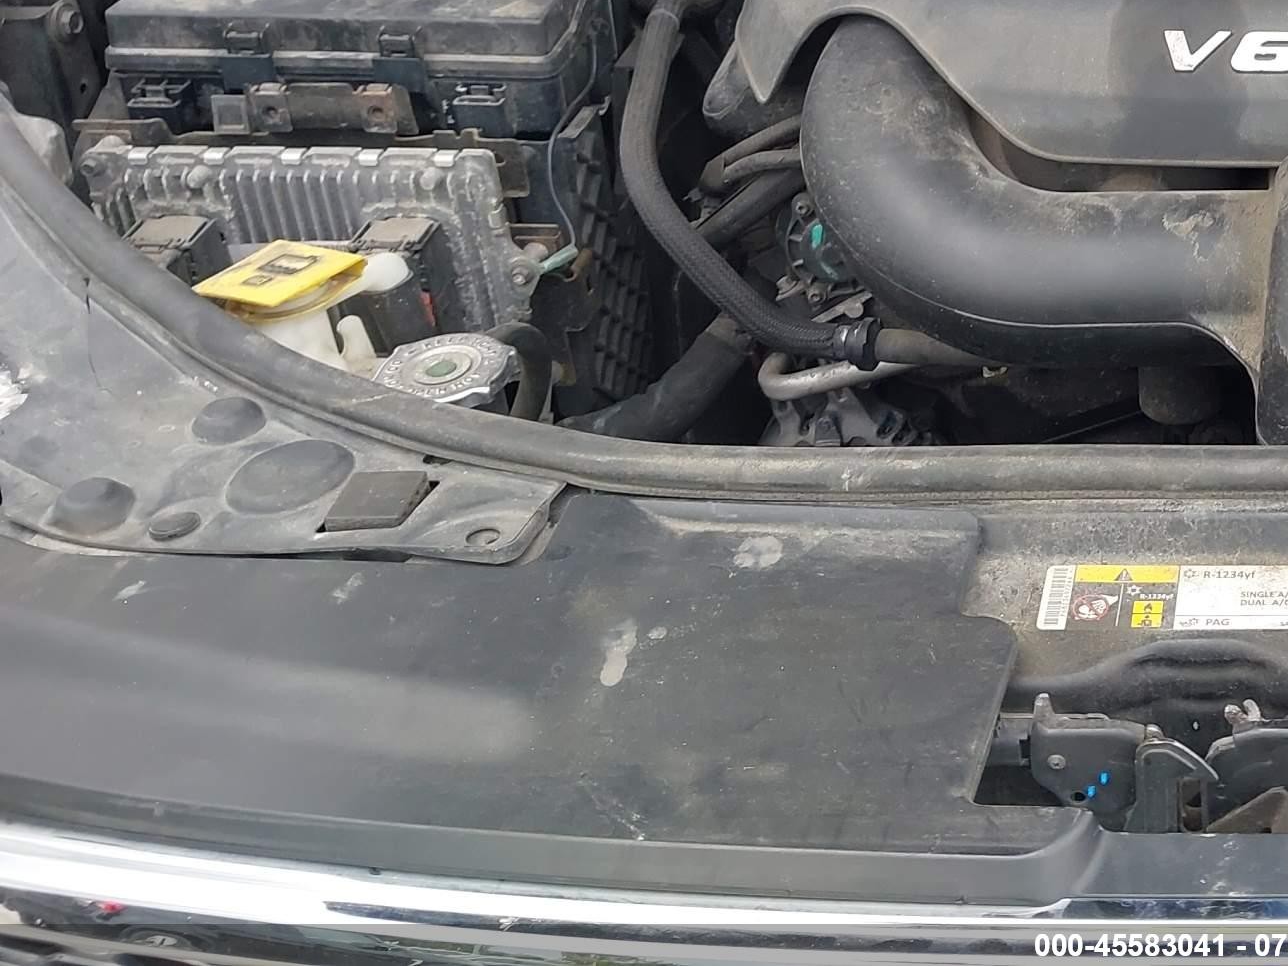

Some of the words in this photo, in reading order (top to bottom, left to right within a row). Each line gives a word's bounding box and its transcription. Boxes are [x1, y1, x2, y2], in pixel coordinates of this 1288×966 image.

[1203, 570, 1256, 580] R-1234yf
[1240, 590, 1275, 598] SINGLE
[1205, 618, 1232, 626] PAG
